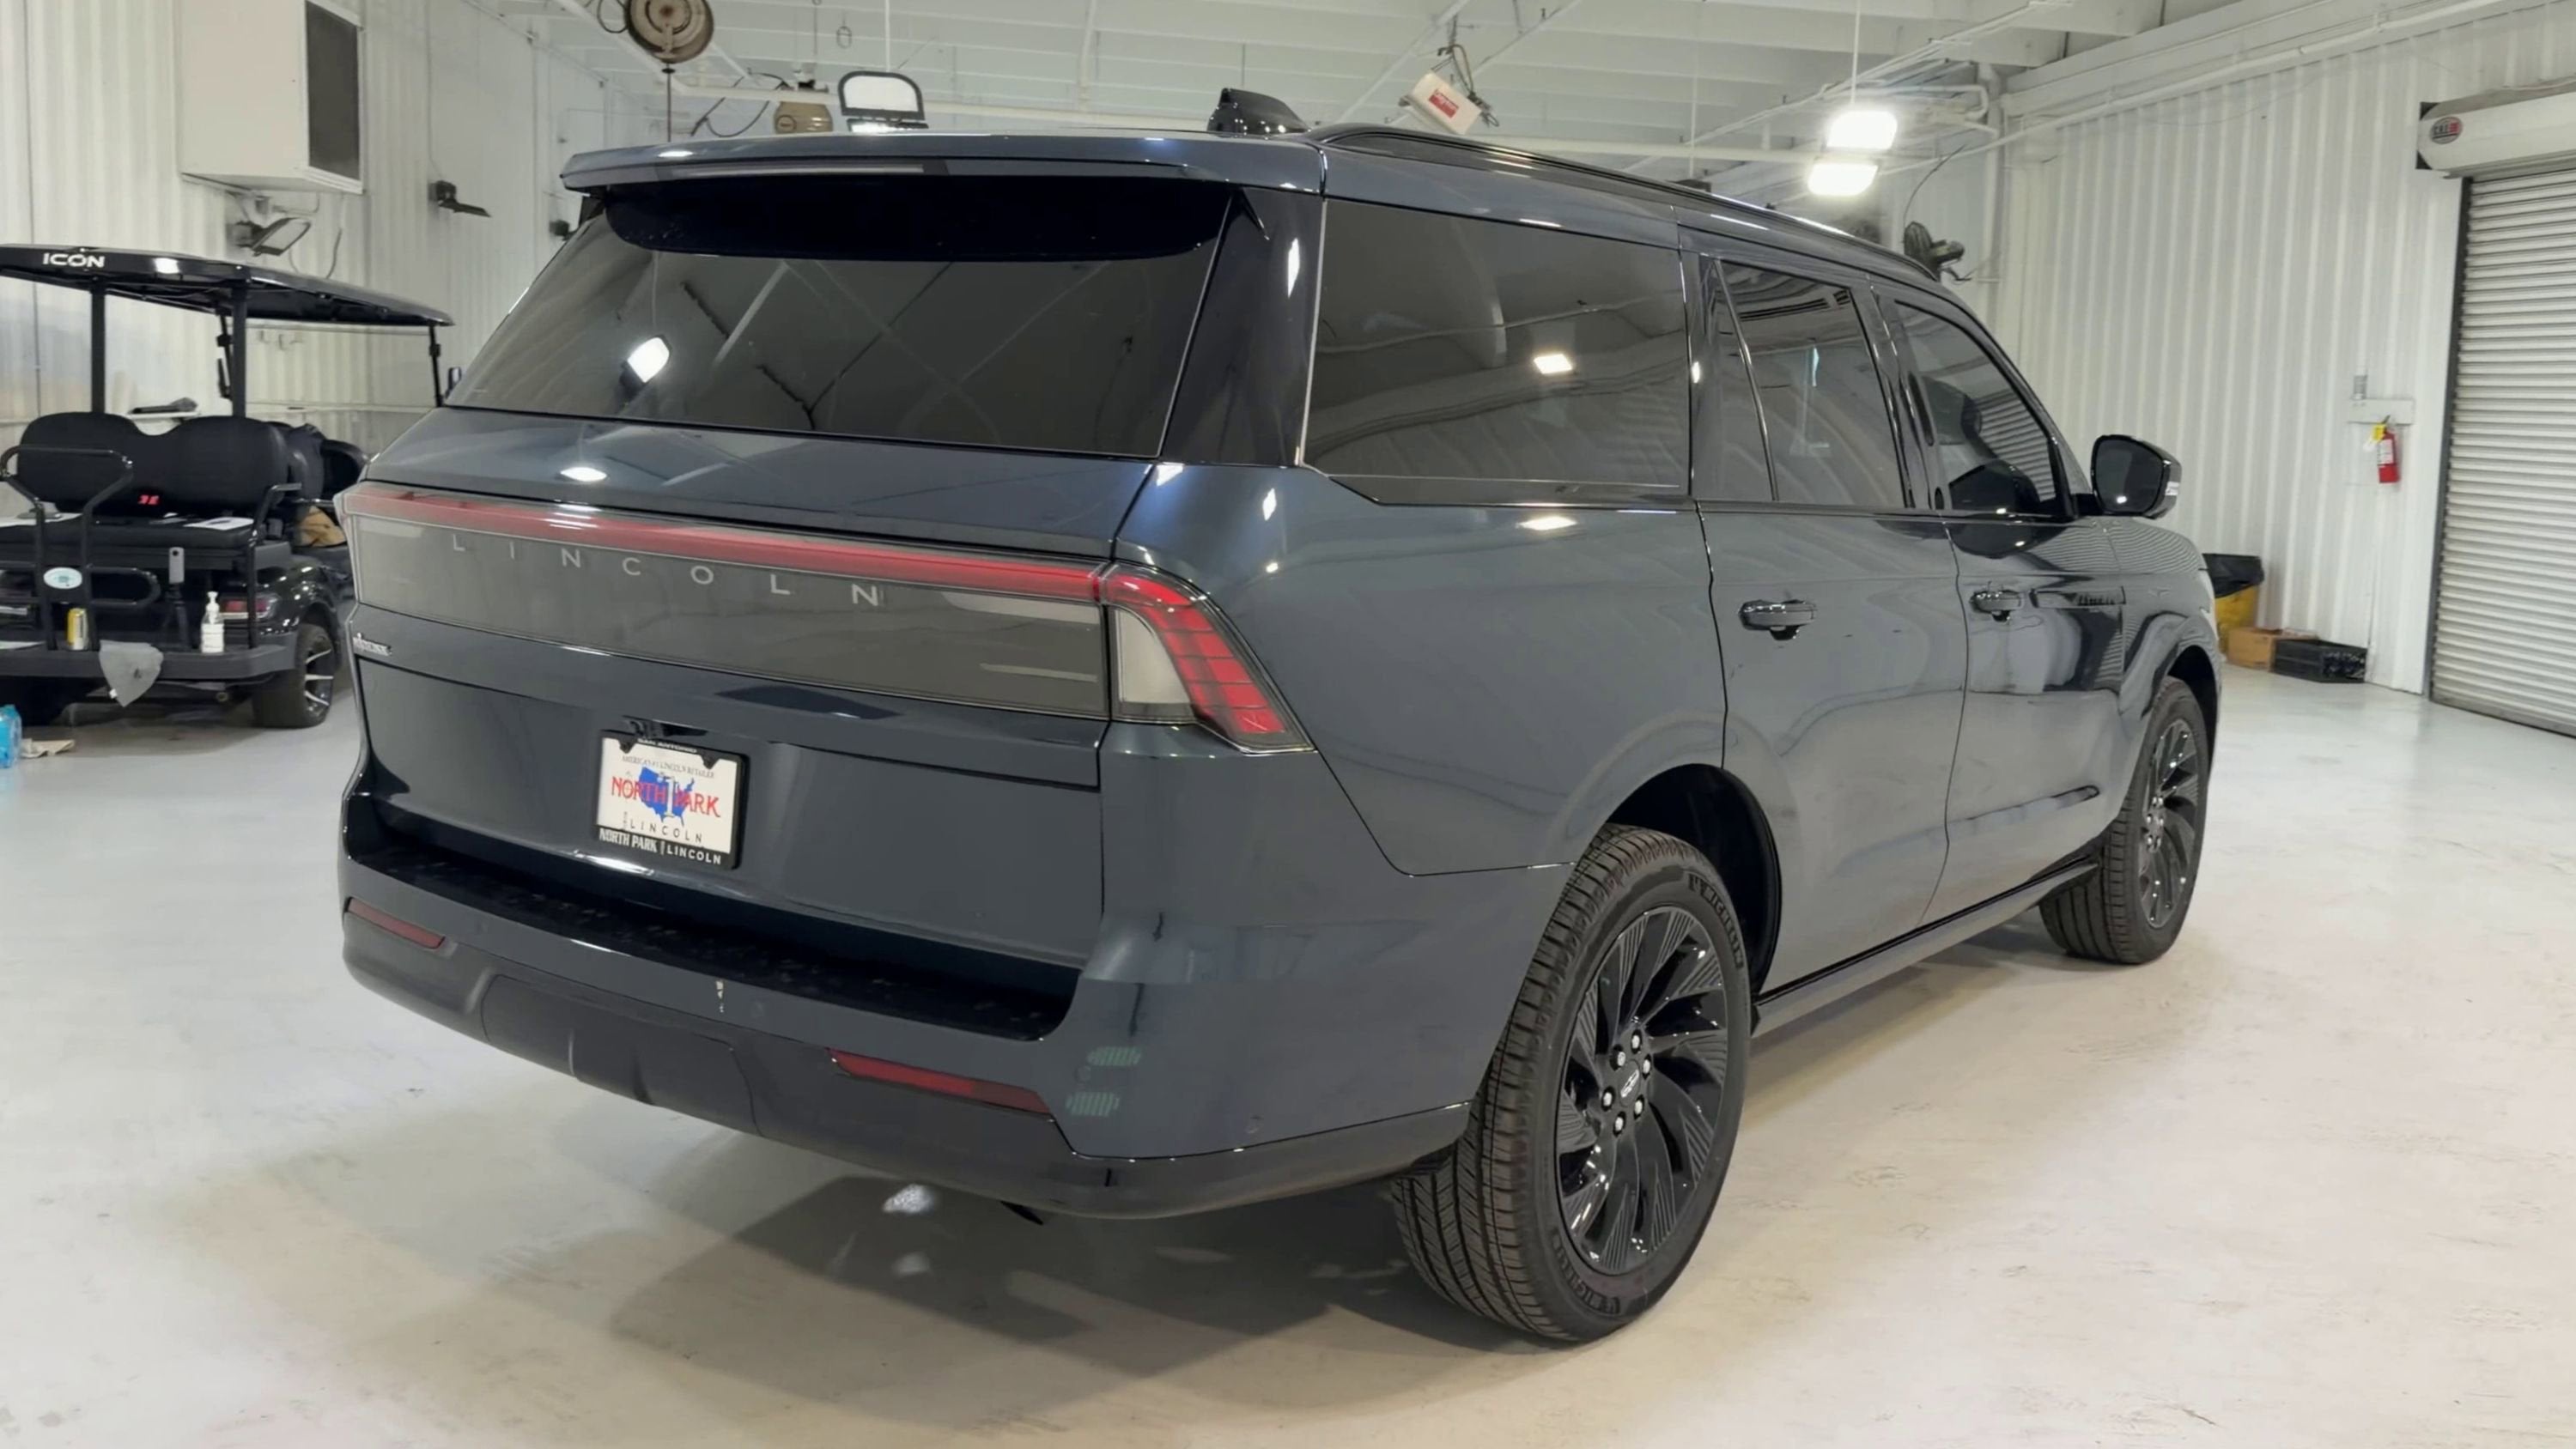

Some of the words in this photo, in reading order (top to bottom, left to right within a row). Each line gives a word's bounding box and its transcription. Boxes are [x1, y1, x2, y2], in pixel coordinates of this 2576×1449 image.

[42, 252, 106, 268] ICON
[452, 533, 880, 606] LINCOLN
[611, 776, 667, 803] NORTH
[673, 785, 721, 818] PARK
[599, 828, 629, 846] NORTH
[631, 834, 658, 853] PARK
[666, 844, 721, 865] LINCOLN
[630, 819, 702, 844] LINCOLN
